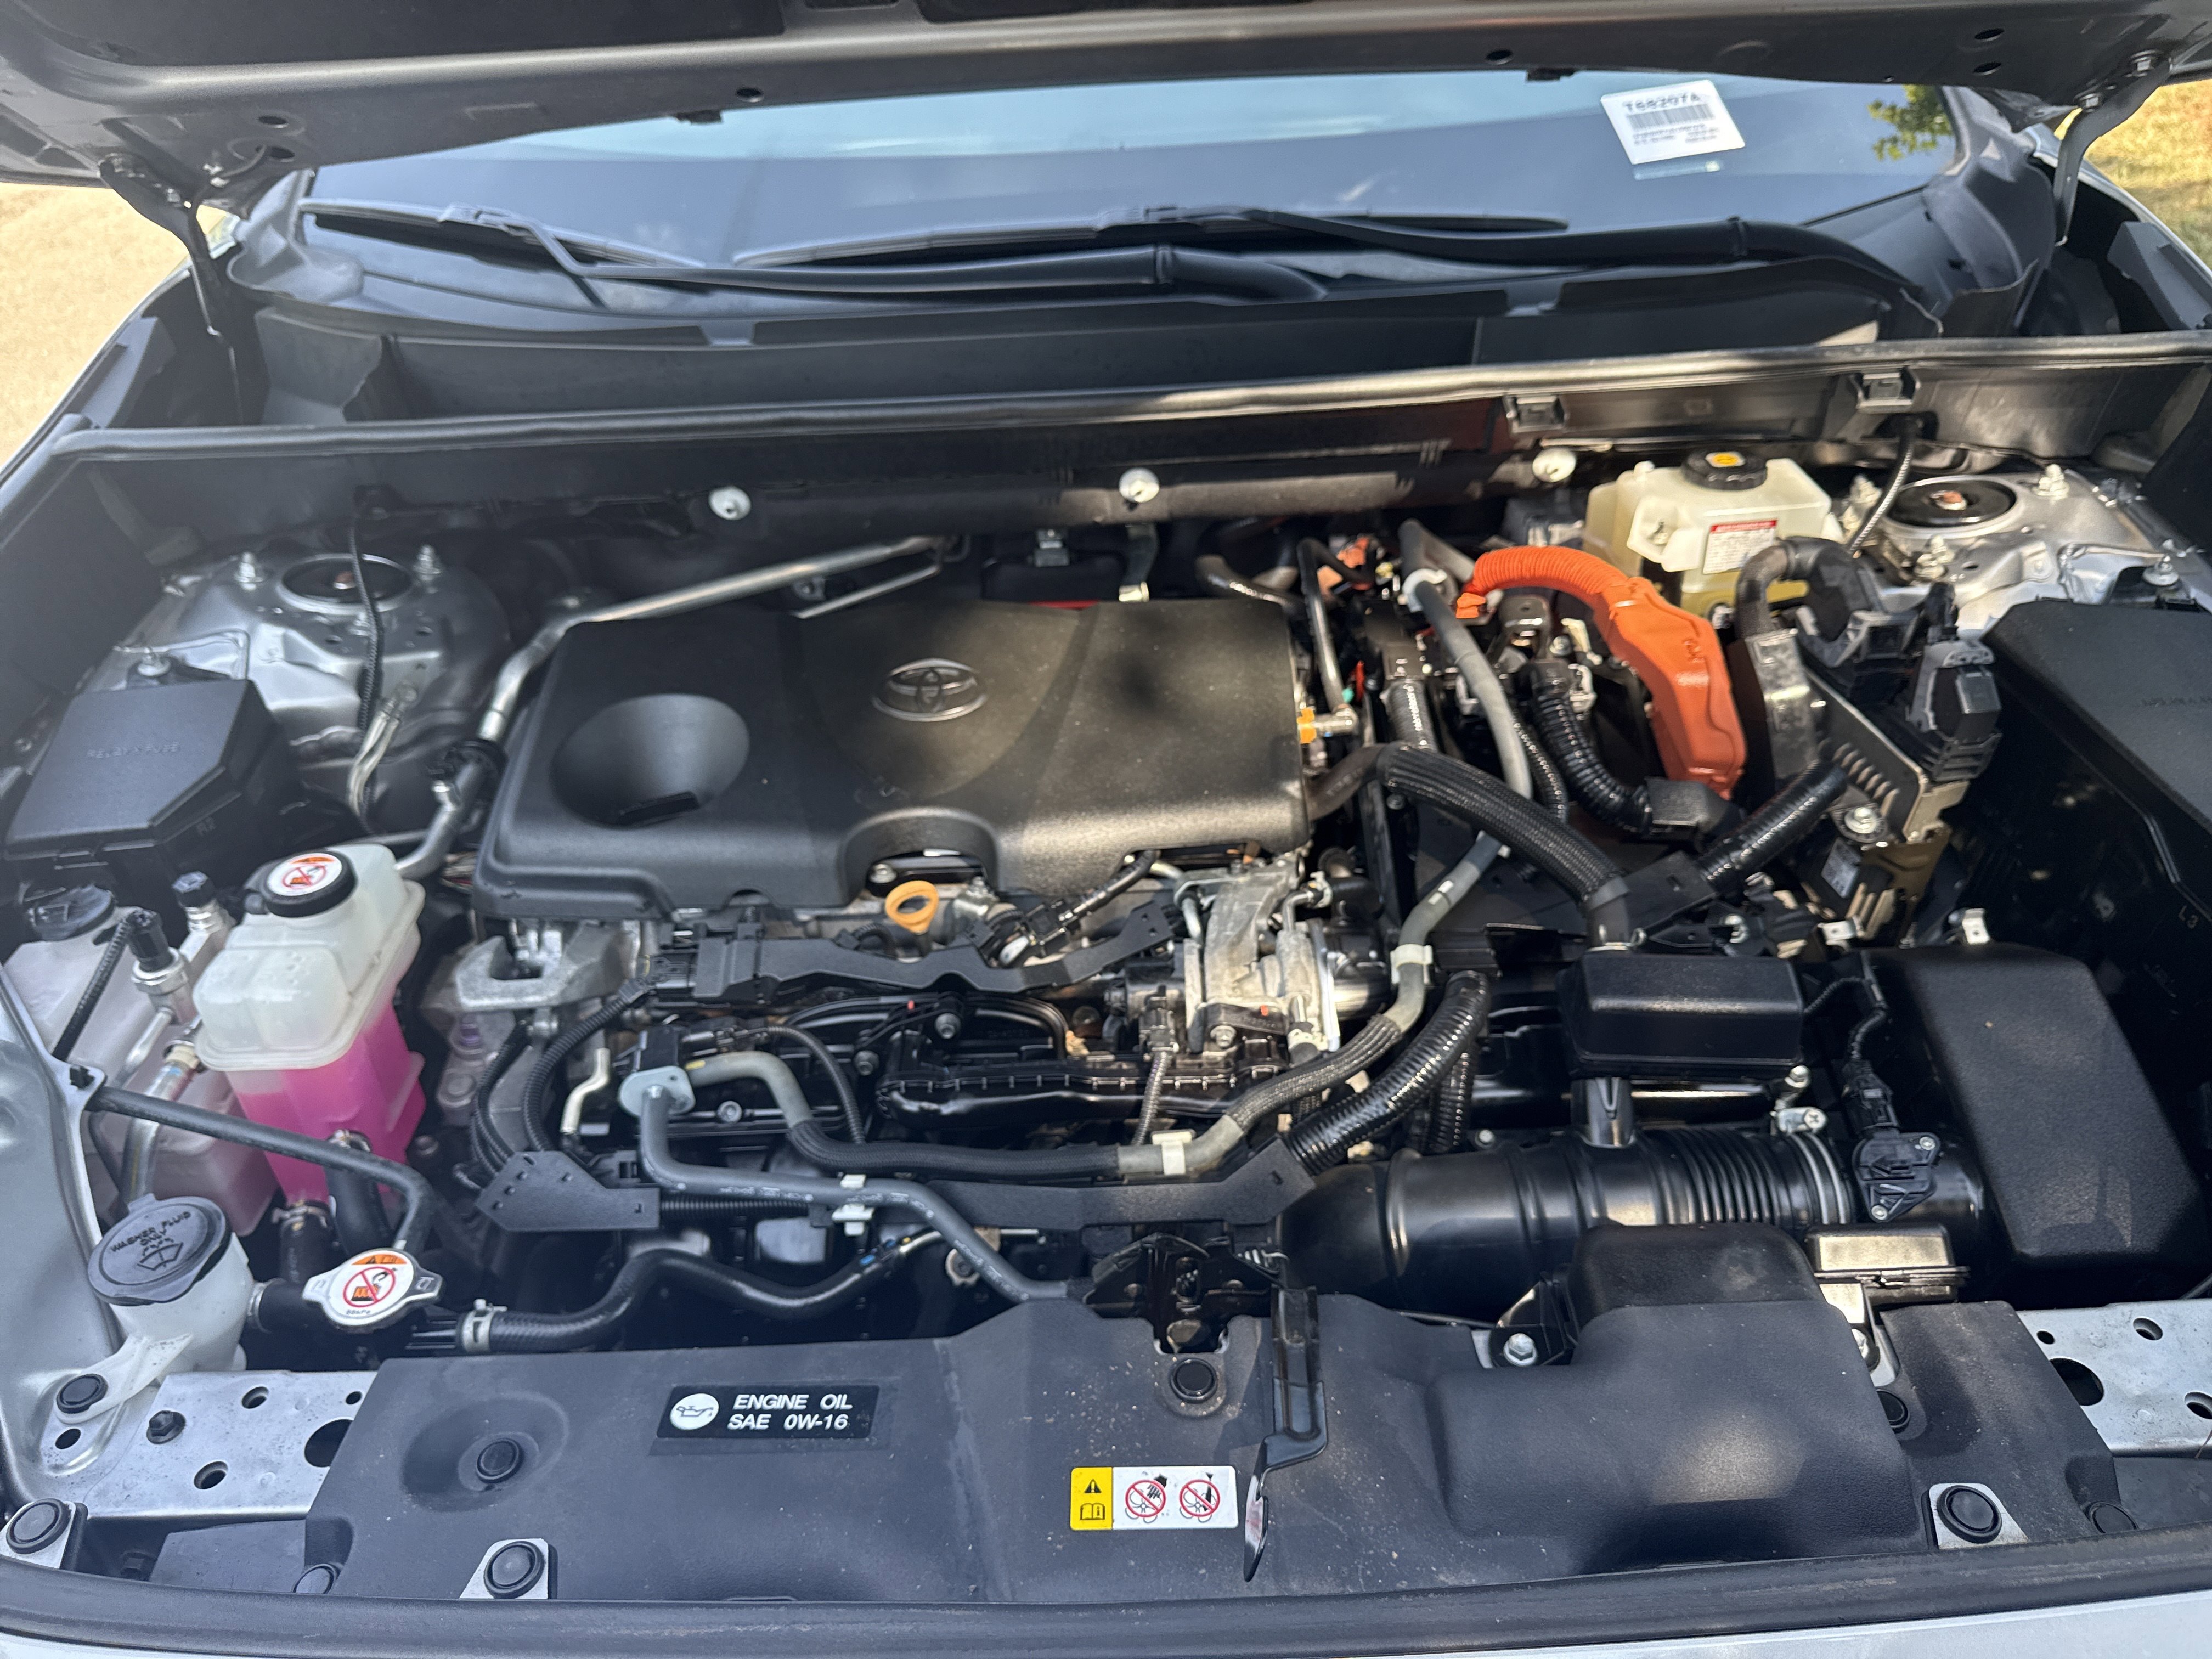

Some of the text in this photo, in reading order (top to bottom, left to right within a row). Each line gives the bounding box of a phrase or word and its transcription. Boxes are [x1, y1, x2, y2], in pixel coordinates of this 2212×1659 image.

[110, 1211, 190, 1252] WASHER FLUID
[140, 1227, 167, 1246] ONLY
[732, 1394, 853, 1410] ENGINE OIL
[727, 1414, 849, 1430] SAE 0W-16
